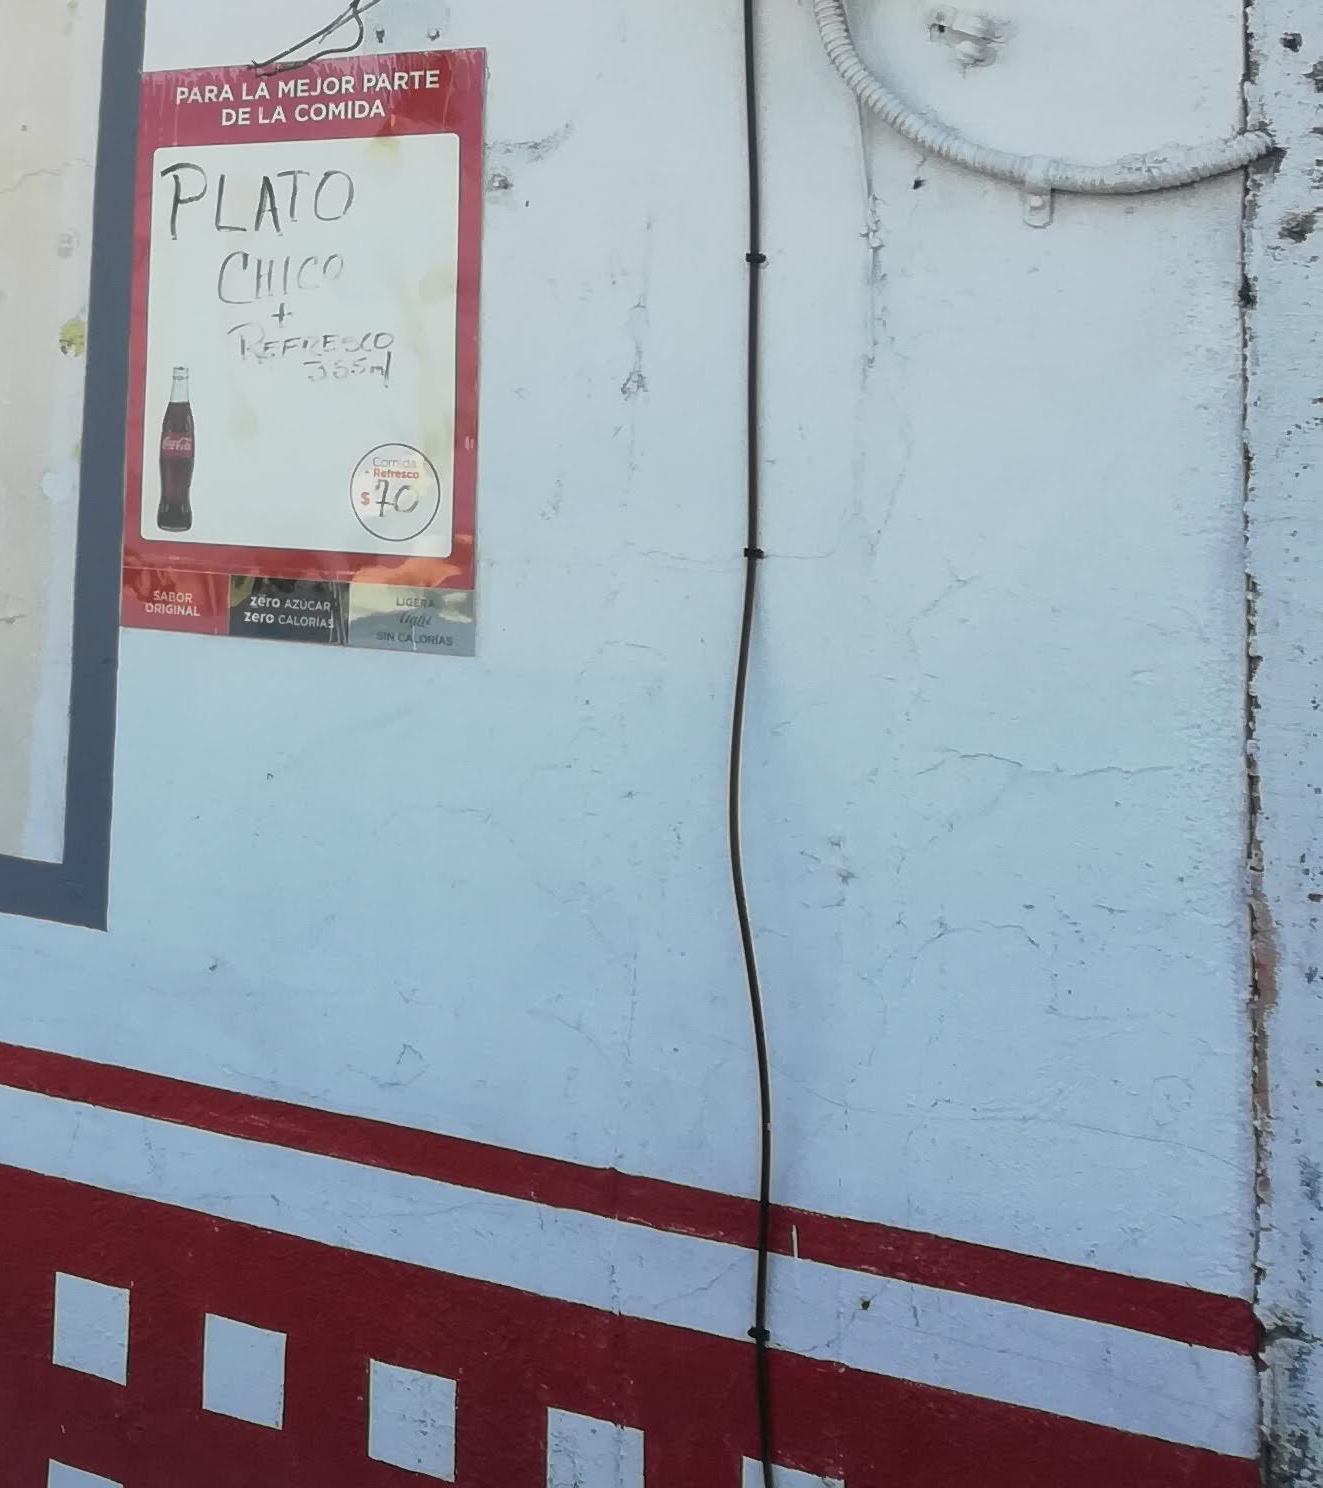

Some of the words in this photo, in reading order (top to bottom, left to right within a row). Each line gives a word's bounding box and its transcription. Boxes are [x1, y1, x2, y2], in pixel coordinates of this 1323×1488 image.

[176, 84, 234, 104] PARA
[241, 82, 270, 101] LA
[277, 76, 355, 99] MEJOR
[363, 70, 441, 93] PARTE
[221, 108, 251, 126] DE
[258, 105, 286, 124] LA
[294, 99, 386, 122] COMIDA
[160, 162, 355, 241] PLATO
[217, 251, 344, 305] CHICO
[226, 322, 395, 364] REFRESCO
[373, 468, 420, 479] Refresco
[153, 590, 193, 603] SABOR
[396, 596, 435, 609] LIGERA
[145, 603, 201, 617] ORIGINAL
[244, 611, 275, 624] zero
[376, 631, 395, 642] SIN
